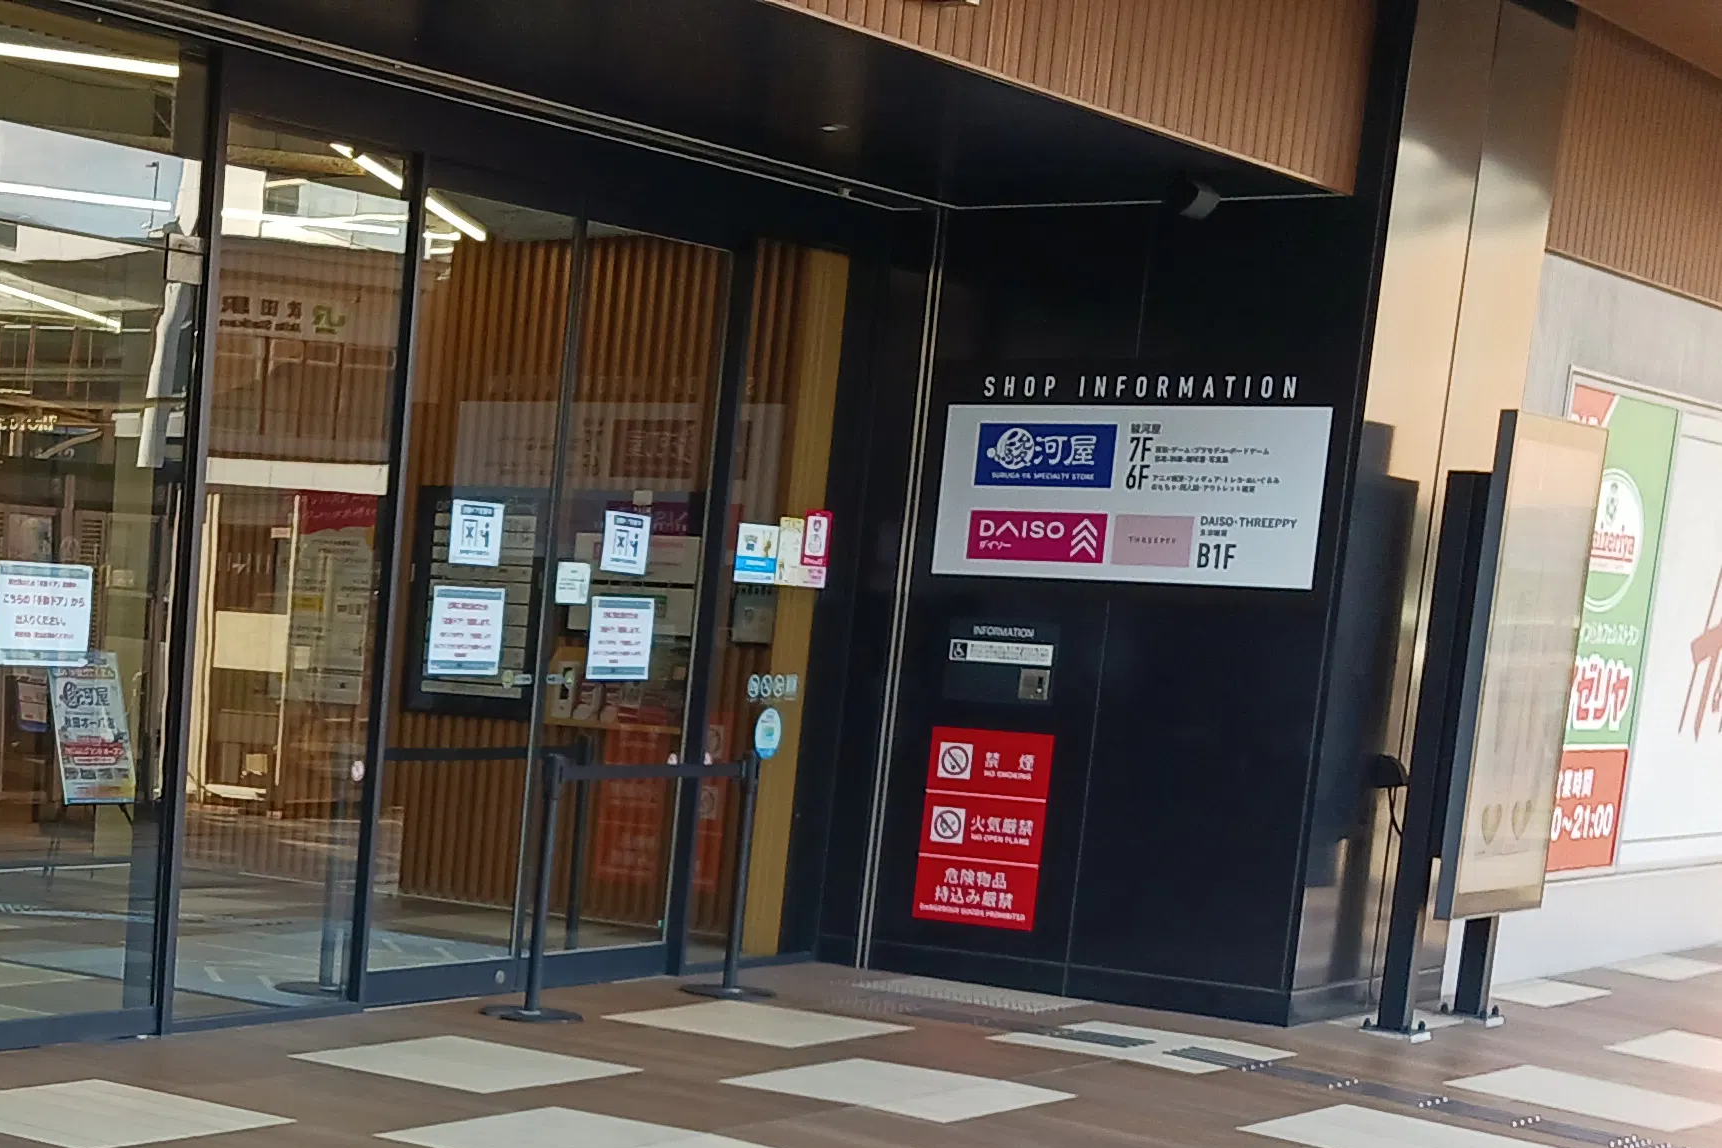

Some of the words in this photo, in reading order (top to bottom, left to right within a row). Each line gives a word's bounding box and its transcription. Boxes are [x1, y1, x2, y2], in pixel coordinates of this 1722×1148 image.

[983, 375, 1056, 397] SHOP
[1079, 375, 1298, 399] INFORMATION
[987, 427, 1097, 469] 駿河屋
[1129, 436, 1154, 462] 7F
[1126, 464, 1151, 490] 6F
[979, 519, 1065, 539] DAISO
[979, 540, 1012, 550] ダイソー
[1197, 542, 1237, 569] B1F
[973, 625, 1035, 639] INFORMATION
[1570, 655, 1632, 729] ゼリヤ
[970, 814, 1034, 836] 火気厳禁
[970, 833, 982, 841] NO
[983, 834, 1003, 843] OPEN
[944, 867, 1007, 890] 危険物品
[935, 885, 1013, 910] 持込み厳禁
